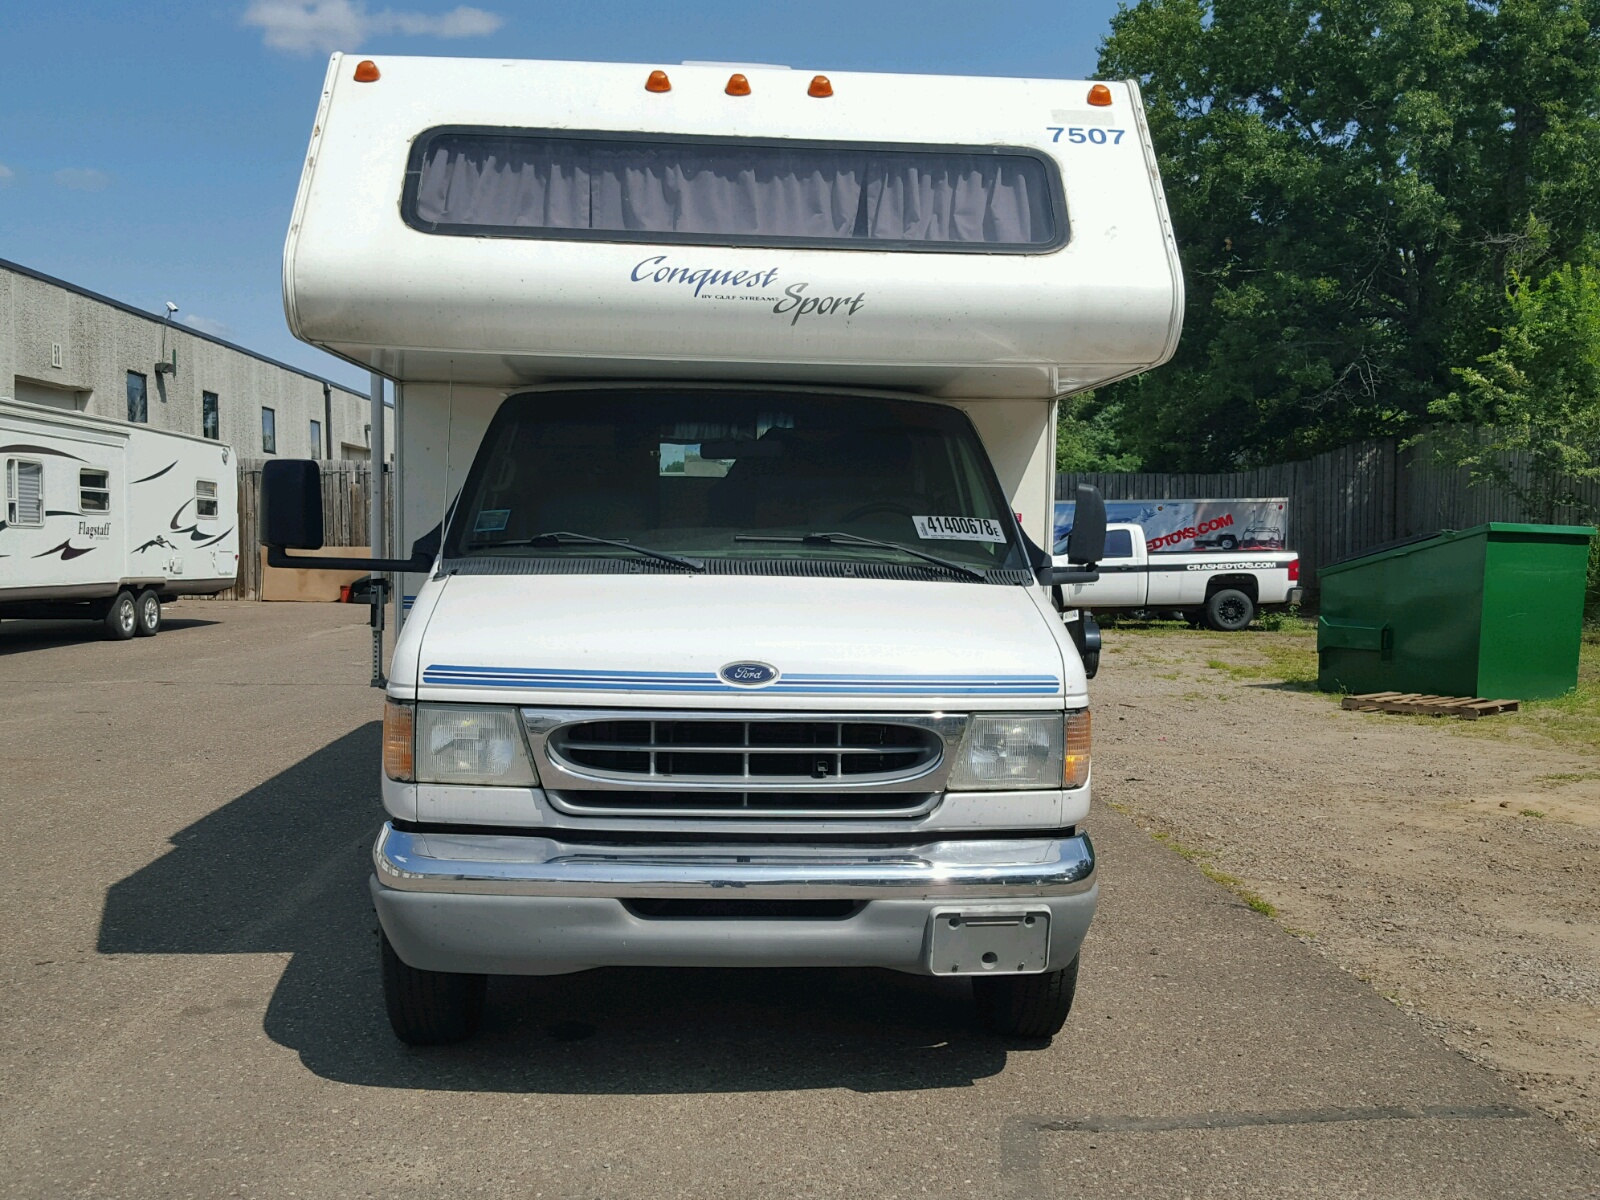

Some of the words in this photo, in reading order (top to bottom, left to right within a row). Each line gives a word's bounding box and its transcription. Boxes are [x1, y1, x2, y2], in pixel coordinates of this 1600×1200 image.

[1046, 127, 1125, 145] 7507
[630, 255, 779, 298] Conquest
[772, 282, 866, 326] Sport
[78, 521, 111, 539] Flagstaff
[1186, 562, 1277, 571] CRASHEDTOYS.COM
[734, 666, 763, 679] Ford
